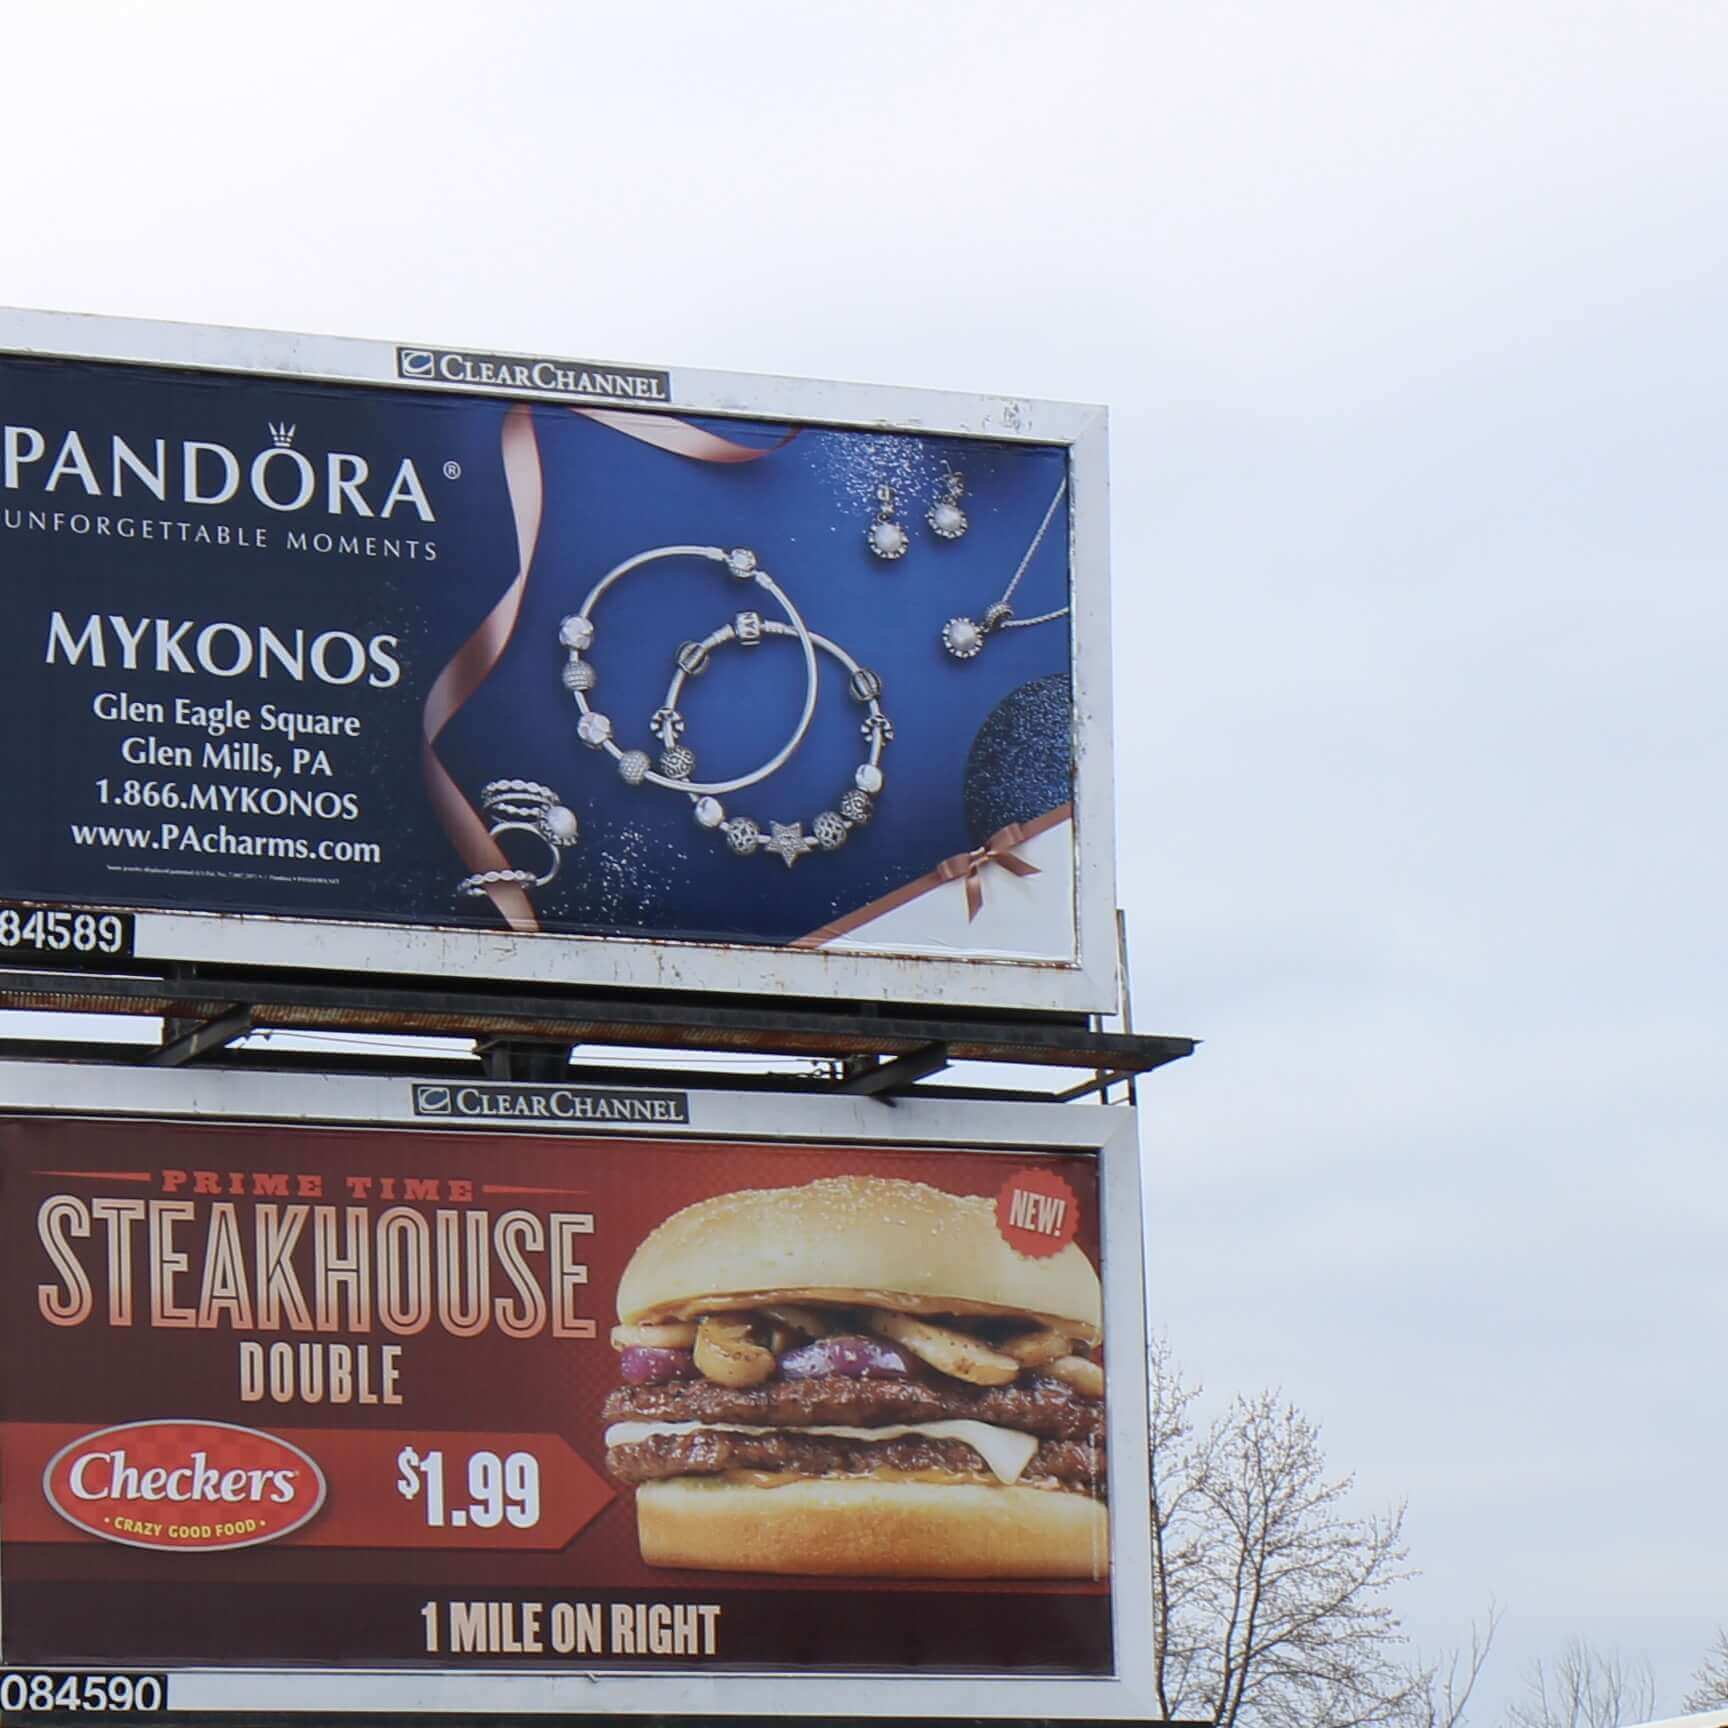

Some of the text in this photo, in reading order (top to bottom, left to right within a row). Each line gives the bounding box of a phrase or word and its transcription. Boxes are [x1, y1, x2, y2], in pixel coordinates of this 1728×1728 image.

[2, 425, 437, 523] PANDORA
[4, 508, 438, 561] UNFORGETTABLE MOMENTS
[45, 610, 402, 689] MYKONOS
[93, 692, 361, 740] Glen Eagle Square
[121, 736, 333, 778] Glen Mills, PA
[95, 776, 359, 821] 1.866.MYKONOS
[71, 822, 382, 864] www.PAcharms.com
[161, 1169, 473, 1202] PRIME TIME
[1008, 1188, 1066, 1238] NEW!
[37, 1194, 598, 1340] STEAKHOUSE
[239, 1341, 403, 1406] DOUBLE
[69, 1450, 296, 1506] Checkers
[396, 1446, 540, 1529] $1.99
[114, 1515, 258, 1540] CRAZY GOOD FOOD
[421, 1602, 721, 1656] 1 MILE ON RIGHT
[0, 1674, 162, 1713] 084590
